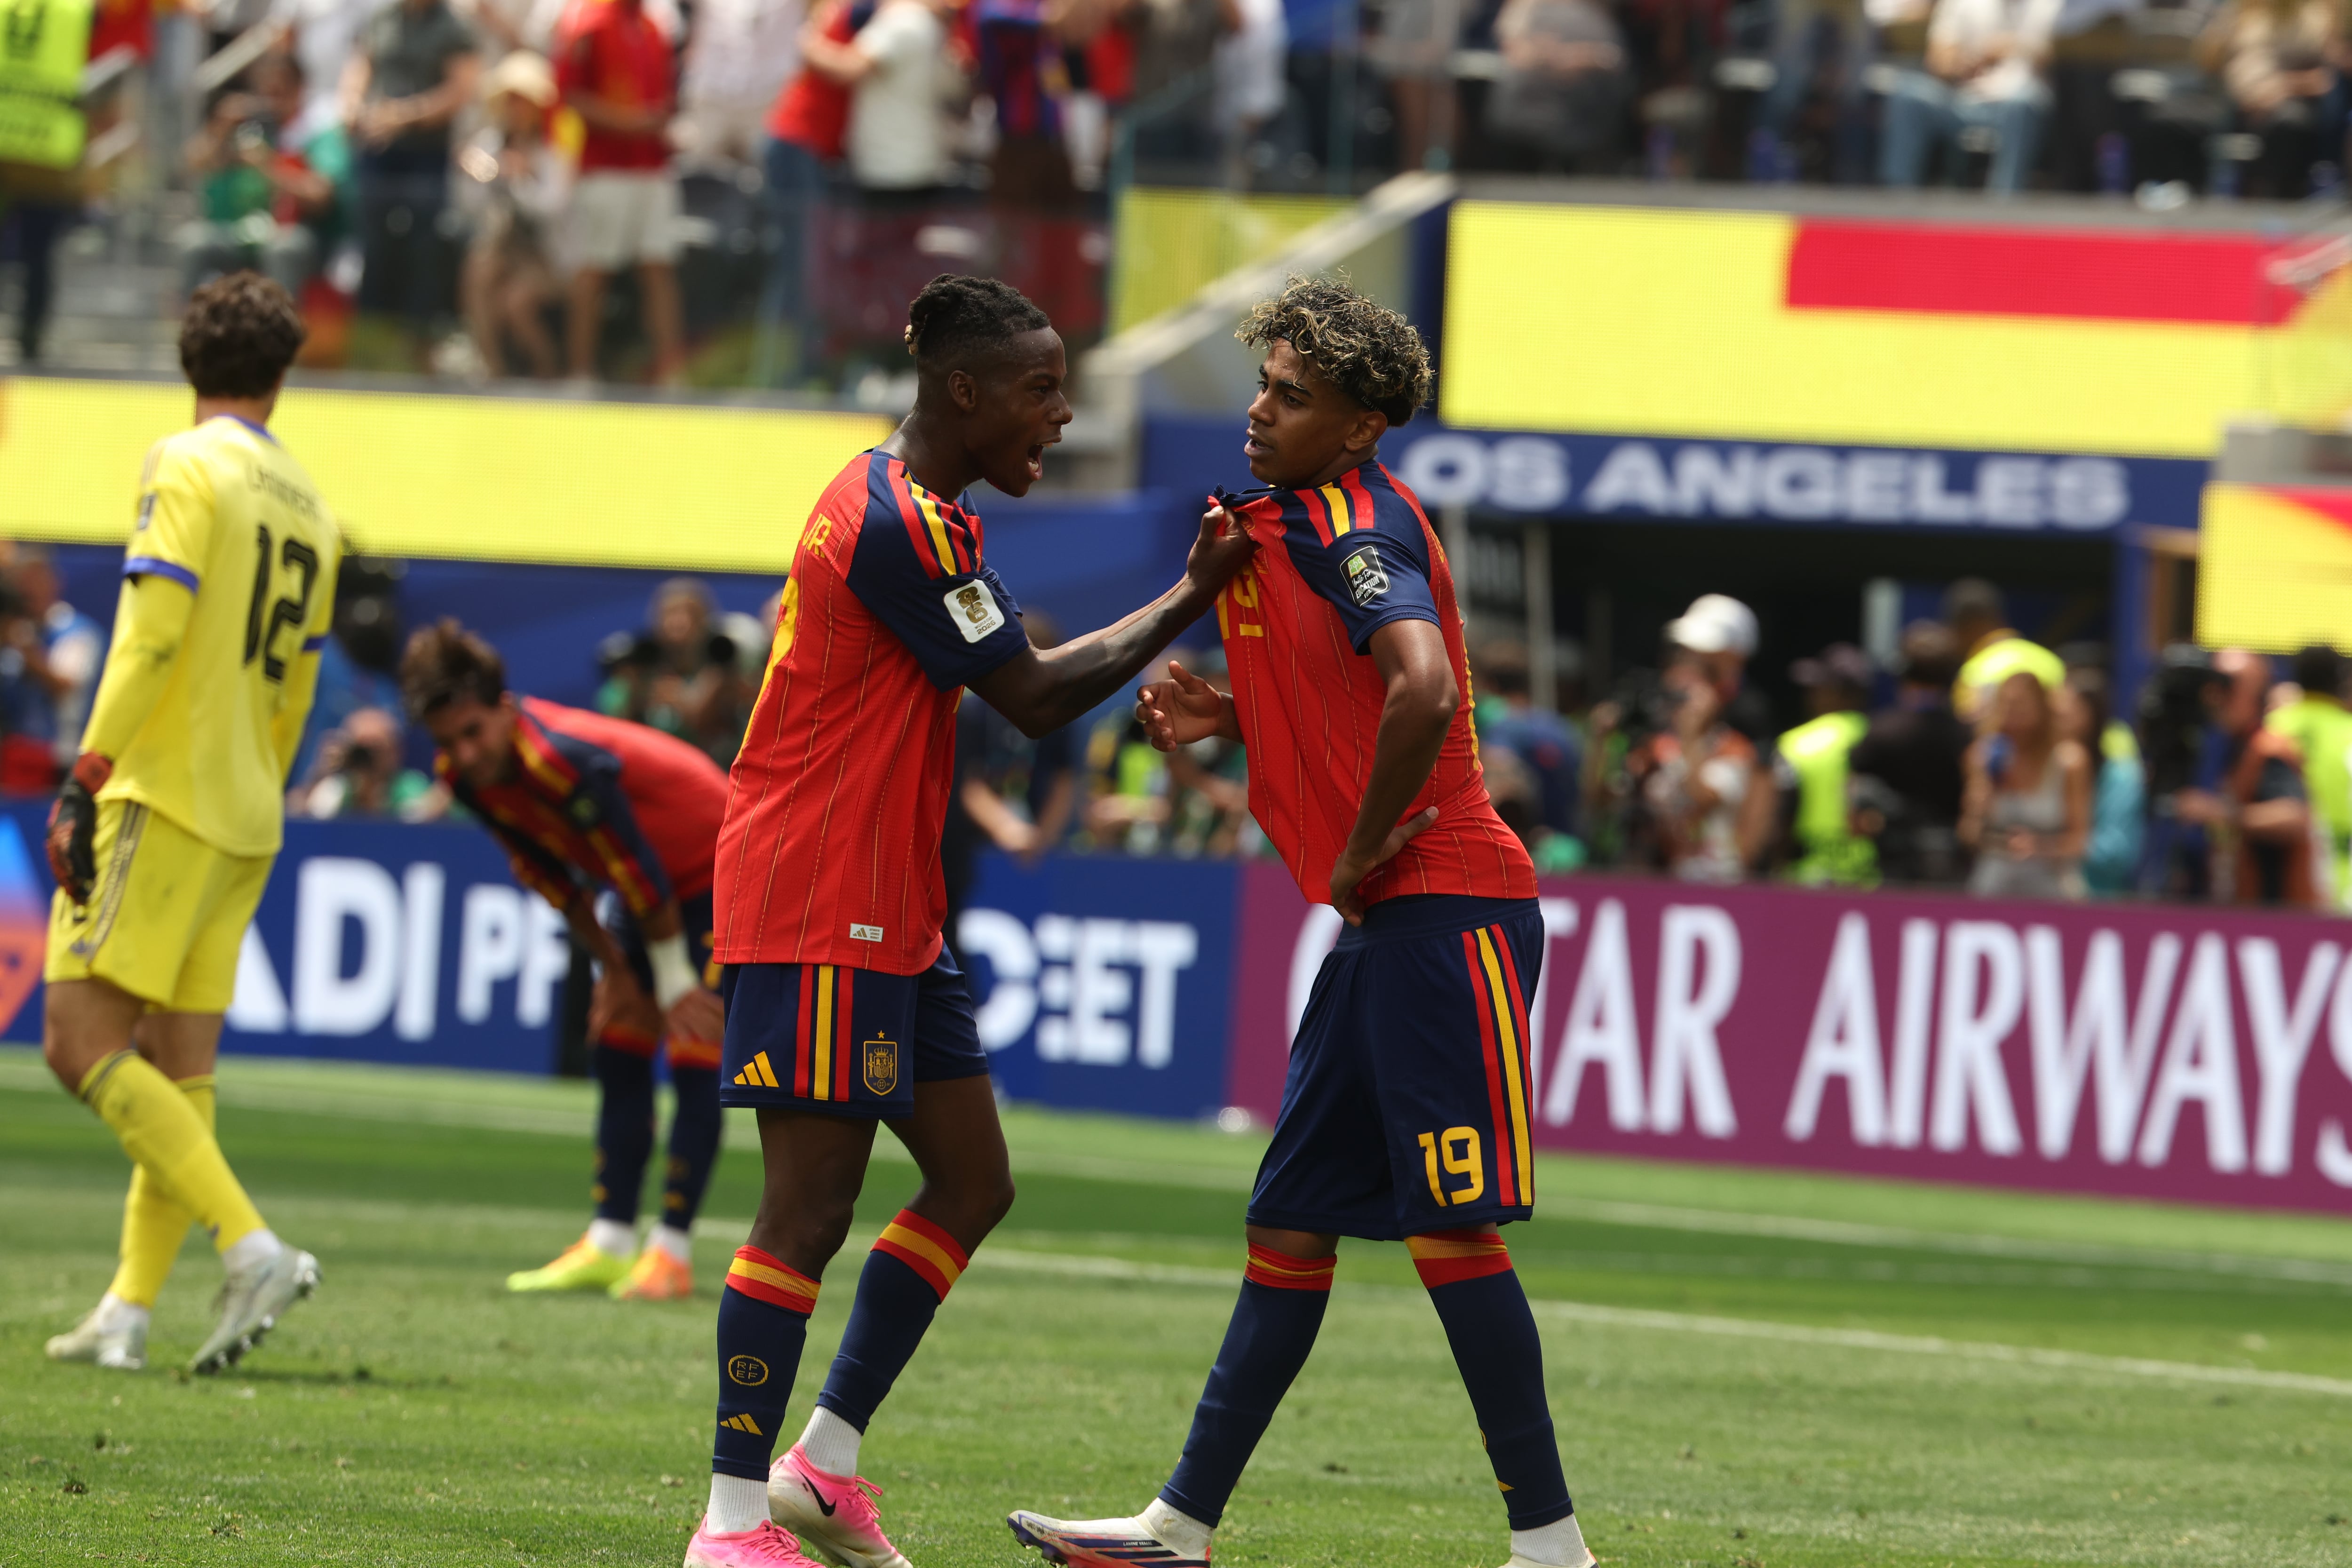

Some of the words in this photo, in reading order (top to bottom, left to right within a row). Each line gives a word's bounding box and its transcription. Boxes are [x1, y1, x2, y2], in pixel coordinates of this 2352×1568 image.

[1393, 433, 1571, 511] OS
[1581, 440, 2131, 530] ANGELES
[242, 522, 318, 684] 12
[977, 620, 996, 635] 2026
[1355, 575, 1380, 599] EDUCATION
[1417, 1126, 1484, 1207] 19
